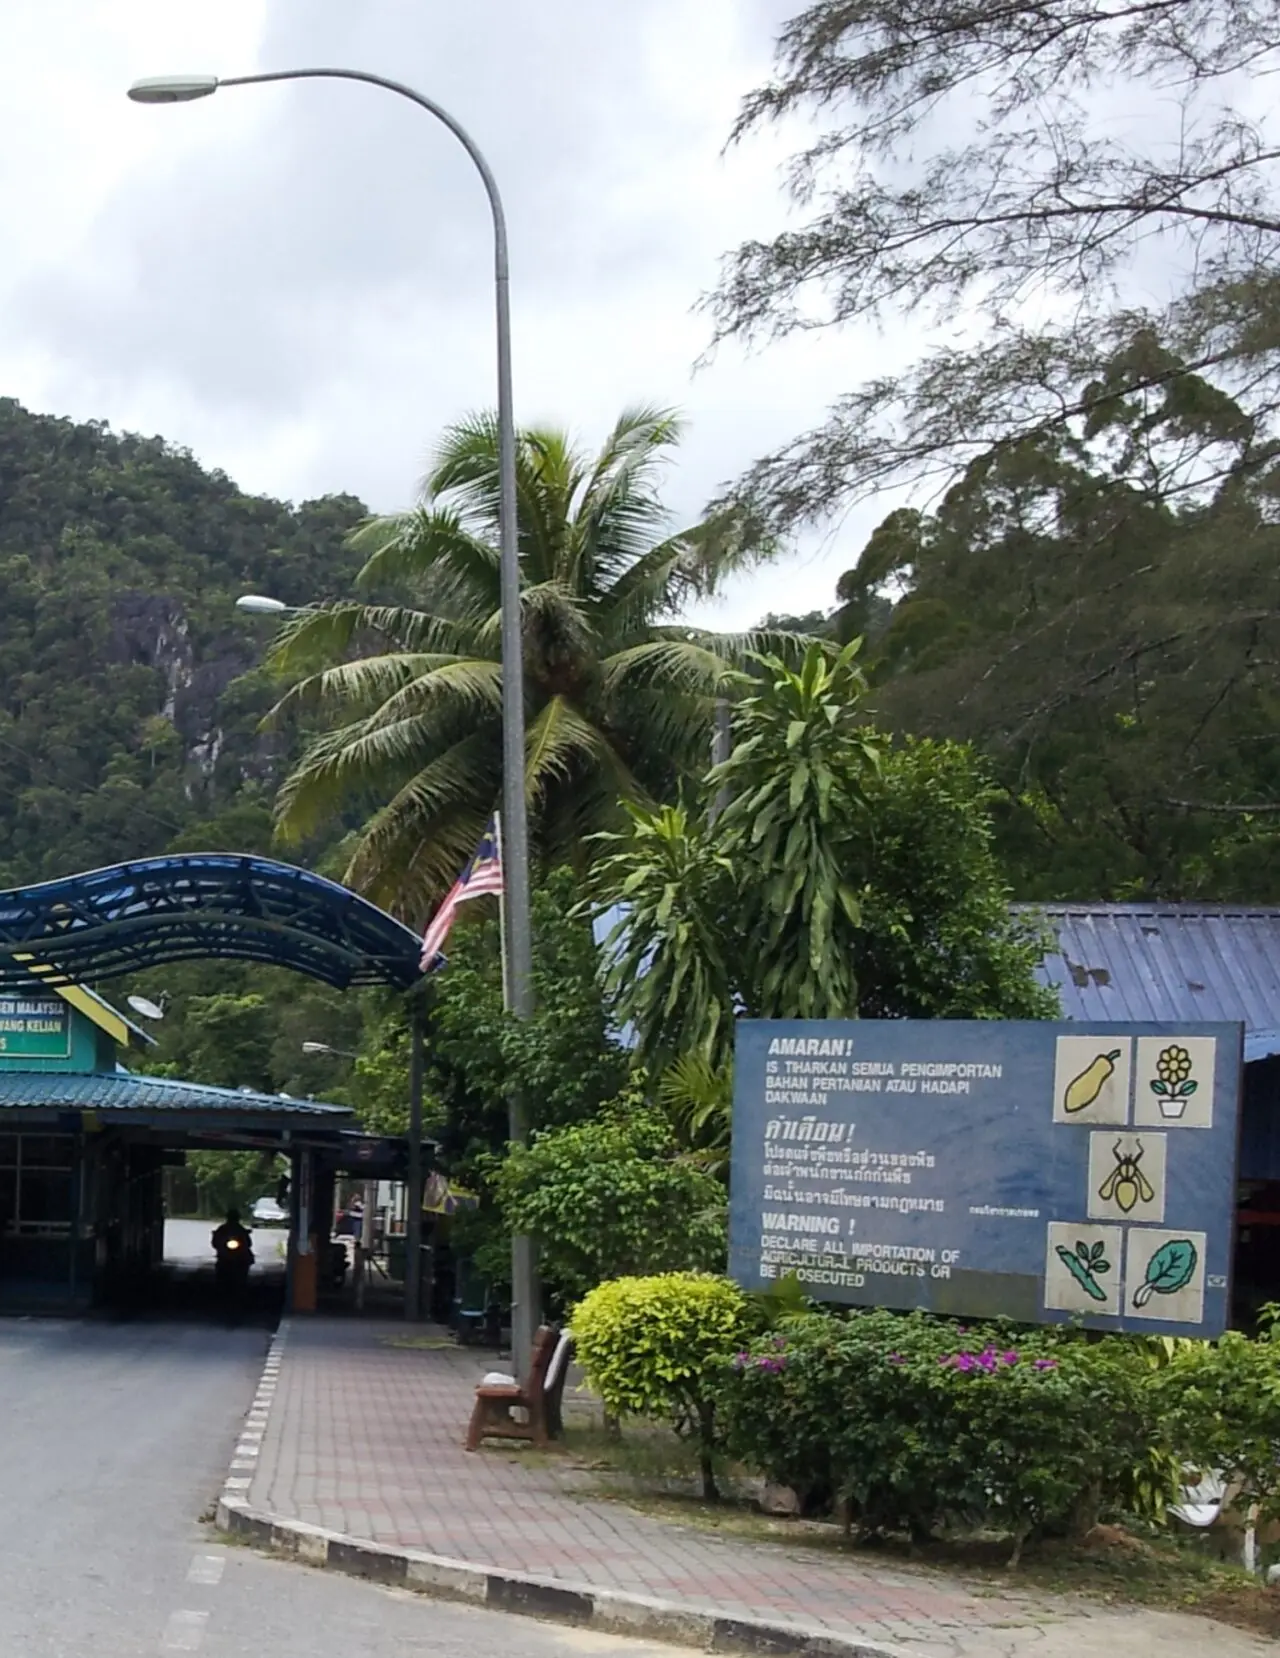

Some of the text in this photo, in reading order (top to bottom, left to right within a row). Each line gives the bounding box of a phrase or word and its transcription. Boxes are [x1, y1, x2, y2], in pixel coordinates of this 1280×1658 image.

[17, 1001, 64, 1014] MALAYSIA
[26, 1020, 61, 1032] KELIAN
[768, 1038, 853, 1057] AMARAN!
[766, 1061, 1002, 1078] IS TIHARKAN SEMUA PENGIMPORTAN
[766, 1076, 969, 1095] BAHAN PERTANIAN ATAU HADAPI
[765, 1091, 827, 1105] DAKWAAN
[762, 1212, 839, 1234] WARNING
[761, 1235, 960, 1263] DECLARE ALL IMPORTATION OF
[760, 1264, 776, 1278] BE
[856, 1258, 925, 1276] PRODUCTS
[931, 1266, 951, 1279] OR
